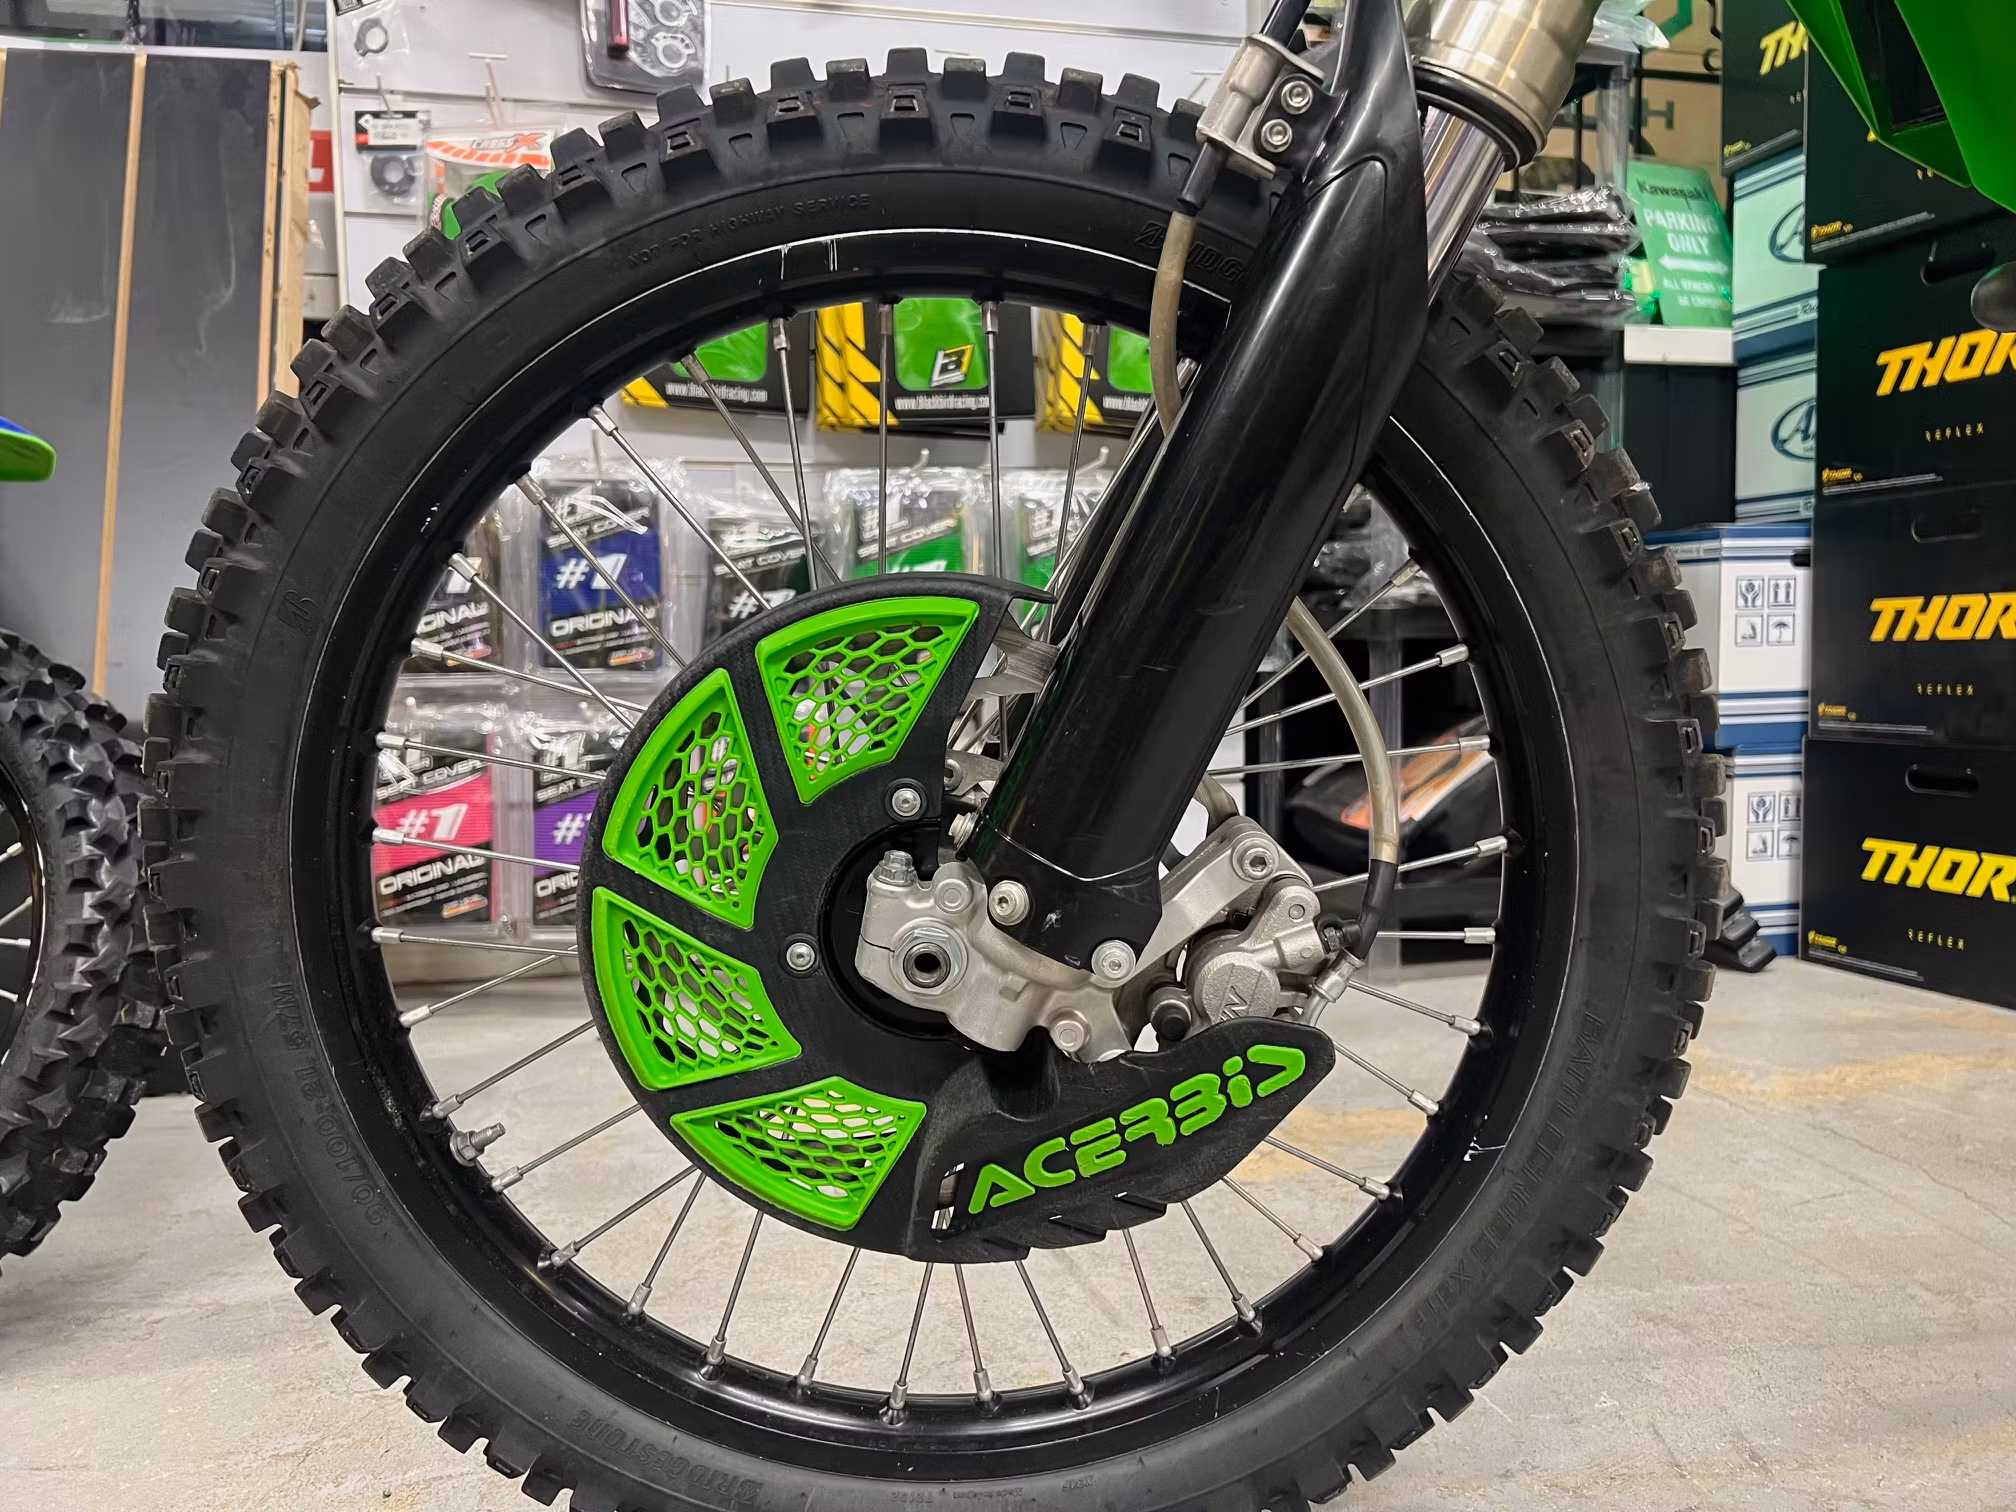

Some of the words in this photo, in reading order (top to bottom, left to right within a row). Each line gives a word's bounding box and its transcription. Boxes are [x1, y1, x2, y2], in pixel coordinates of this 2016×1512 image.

[628, 243, 659, 266] NOT
[668, 228, 701, 248] FOR
[793, 193, 871, 215] SERVICE
[1642, 208, 1720, 234] PARKING
[1666, 232, 1710, 256] ONLY
[664, 382, 768, 403] www.blabirdracing.com
[894, 394, 990, 411] www.blackbirdracing.co
[1924, 422, 1985, 442] REFLEX
[757, 547, 806, 567] COVE
[1870, 591, 2016, 642] THOR
[1917, 683, 1974, 696] REFLEX
[536, 779, 576, 802] SEAT
[396, 802, 468, 841] #1
[1860, 836, 2016, 903] THOR
[1907, 927, 1966, 951] REFLEX
[568, 1408, 764, 1504] BRIDGESTONE
